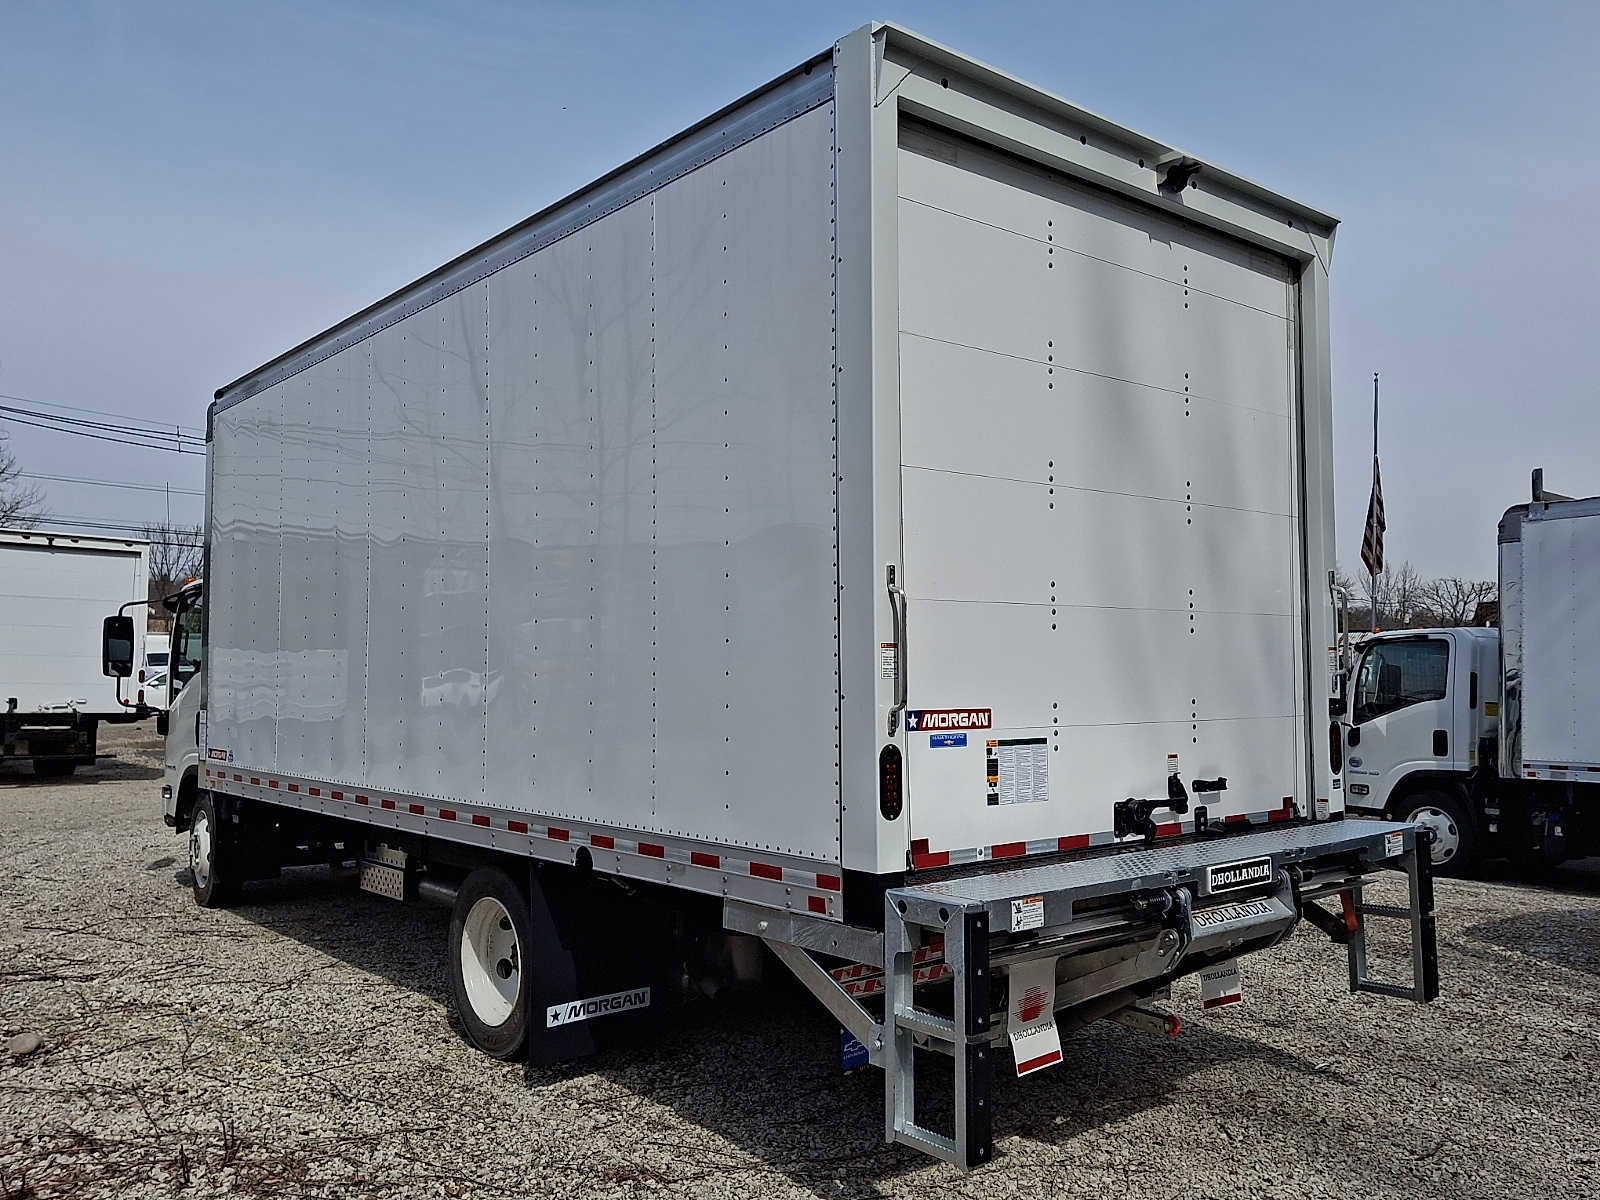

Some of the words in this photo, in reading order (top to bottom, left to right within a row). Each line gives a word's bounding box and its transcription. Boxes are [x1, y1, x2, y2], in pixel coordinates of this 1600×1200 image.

[922, 713, 989, 728] MORGAN
[1211, 864, 1270, 886] DHOLLANDIA
[1195, 901, 1272, 927] DHOLLANDIA
[568, 992, 646, 1019] MORGAN
[1013, 1021, 1055, 1041] DHOLLANDIA
